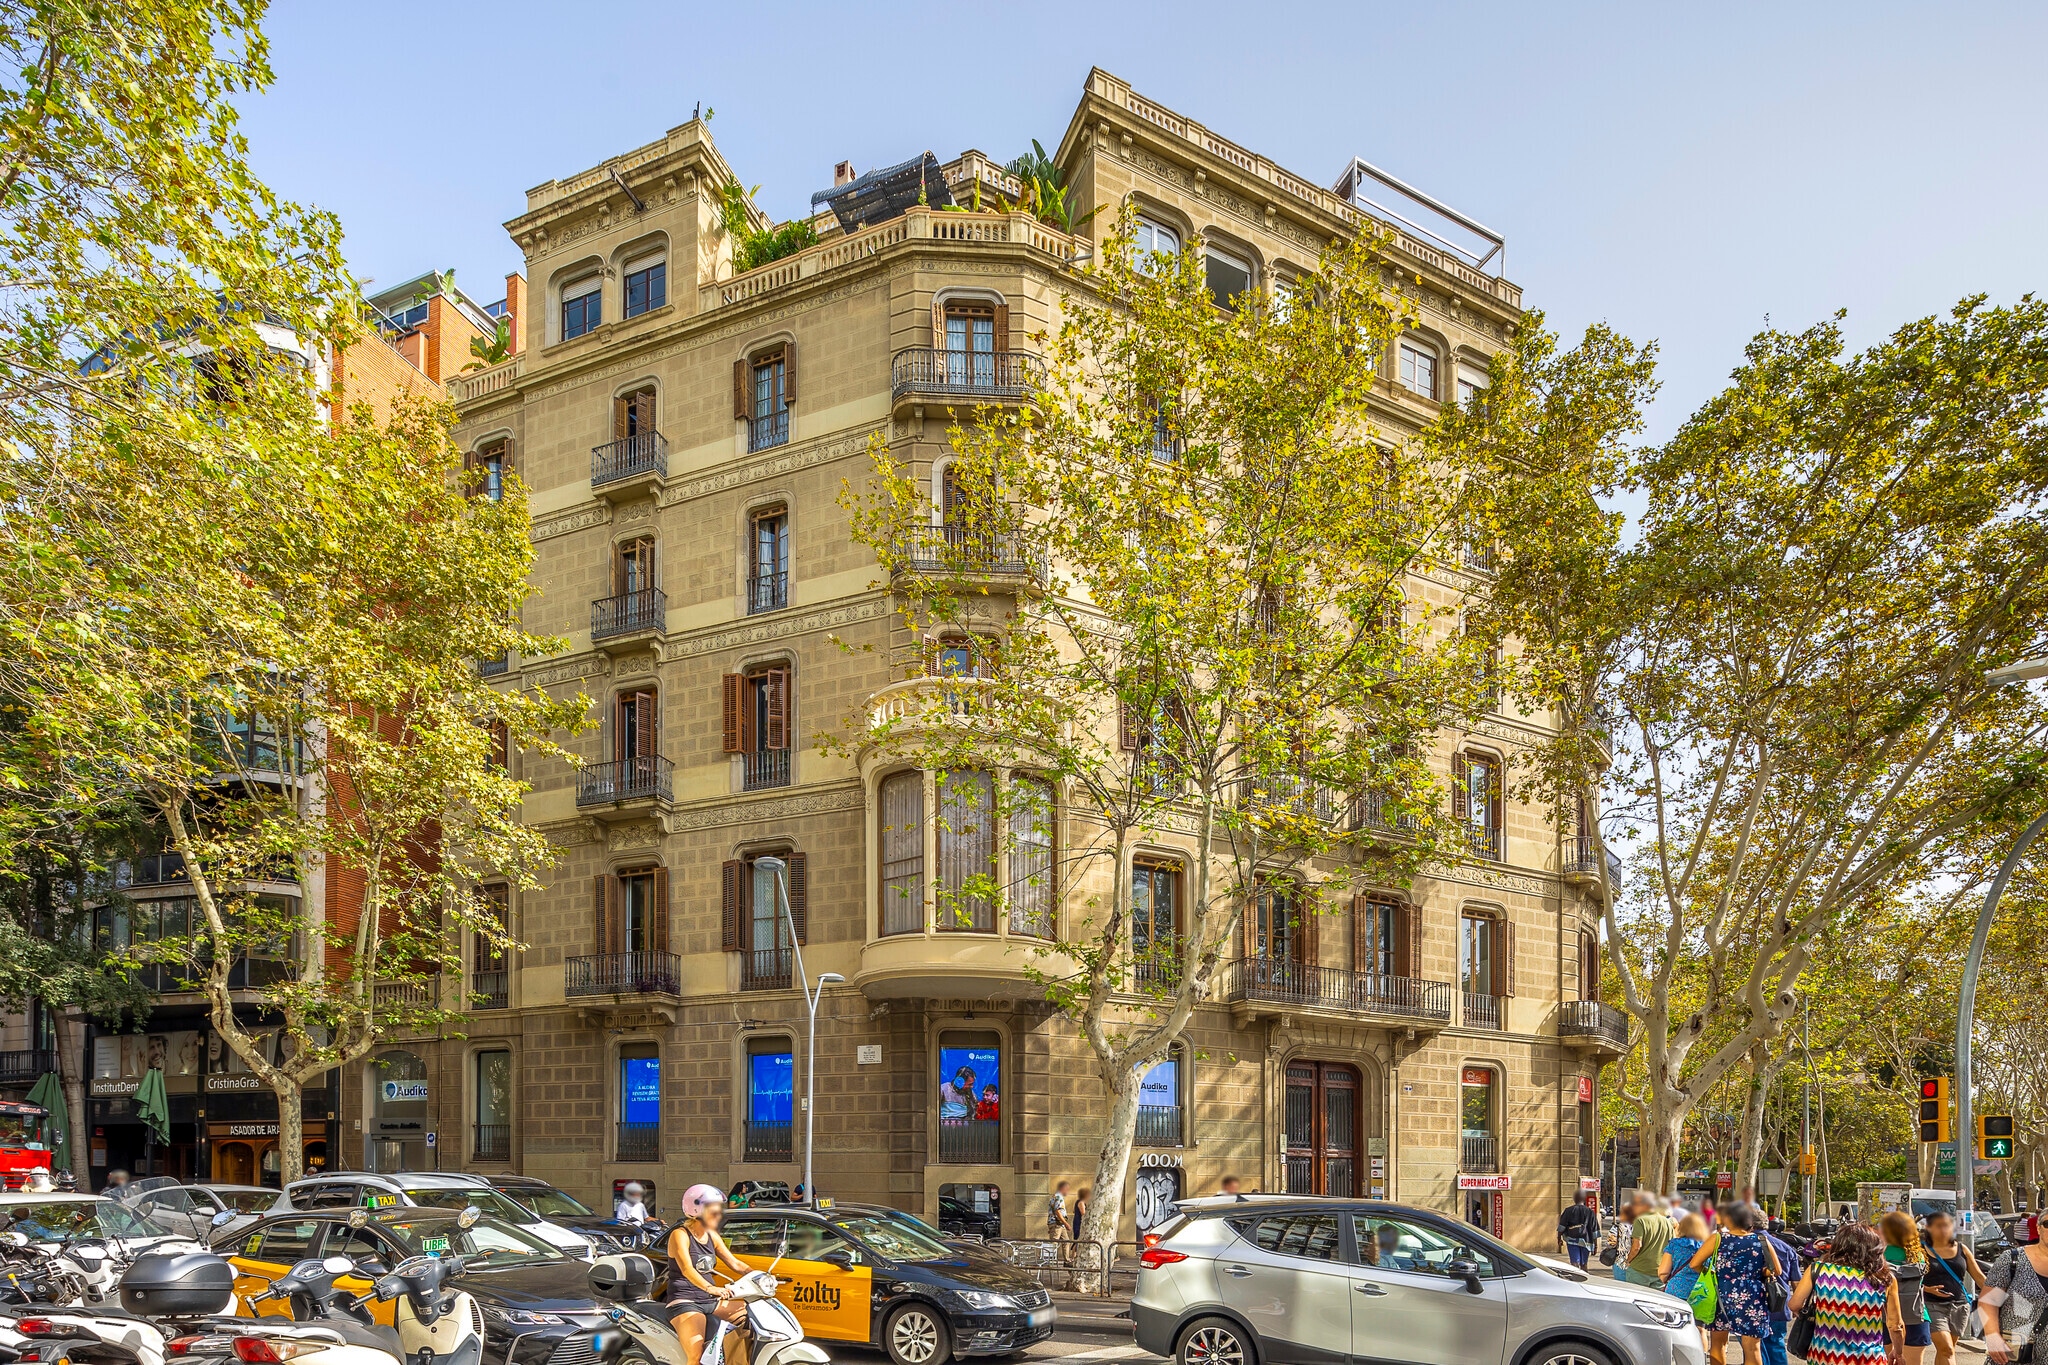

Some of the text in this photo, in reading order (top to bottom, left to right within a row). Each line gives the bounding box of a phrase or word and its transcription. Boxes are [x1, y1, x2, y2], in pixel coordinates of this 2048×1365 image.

[208, 1077, 259, 1089] CristinaGras
[1140, 1082, 1168, 1090] Audika
[230, 1125, 256, 1135] ASADOR
[256, 1125, 266, 1134] DE
[1460, 1178, 1508, 1187] SUPERMERCAT 24
[377, 1195, 397, 1207] TAXI
[819, 1198, 831, 1208] TAXI
